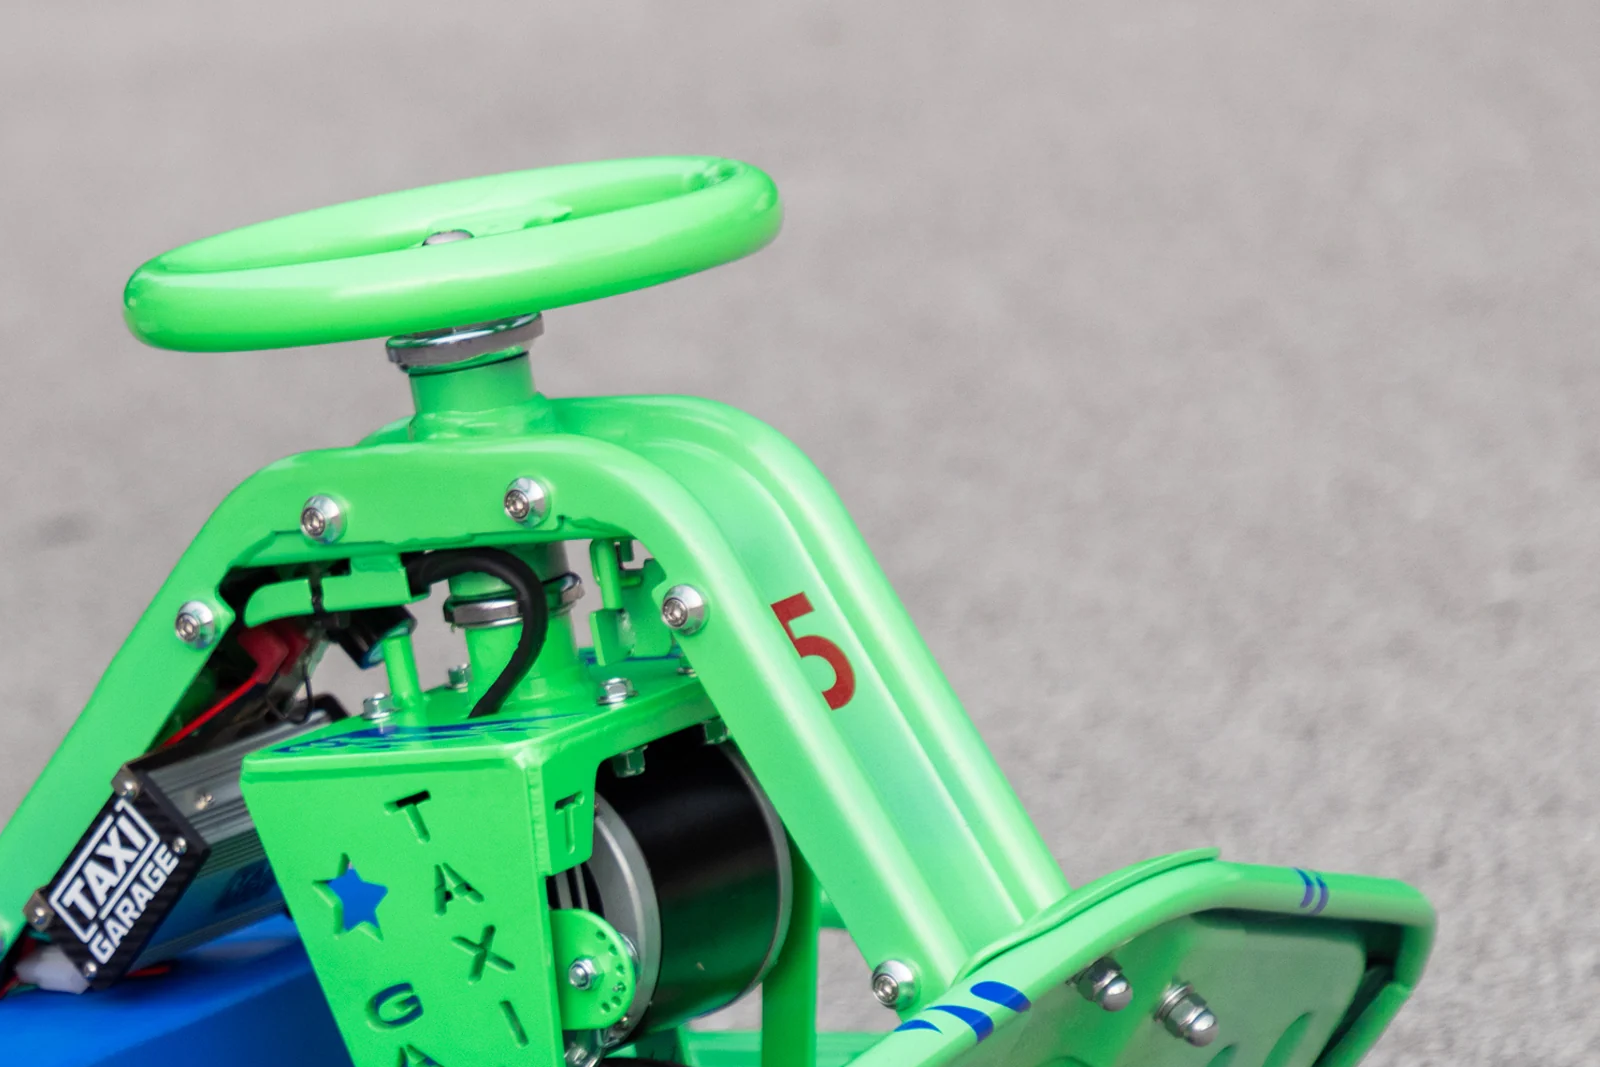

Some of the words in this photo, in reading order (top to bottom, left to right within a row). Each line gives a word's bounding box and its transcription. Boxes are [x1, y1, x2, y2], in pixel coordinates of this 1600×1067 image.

[770, 591, 856, 711] 5
[60, 815, 148, 921] TAXI
[88, 843, 180, 965] GARAGE
[384, 789, 529, 1048] TAXI
